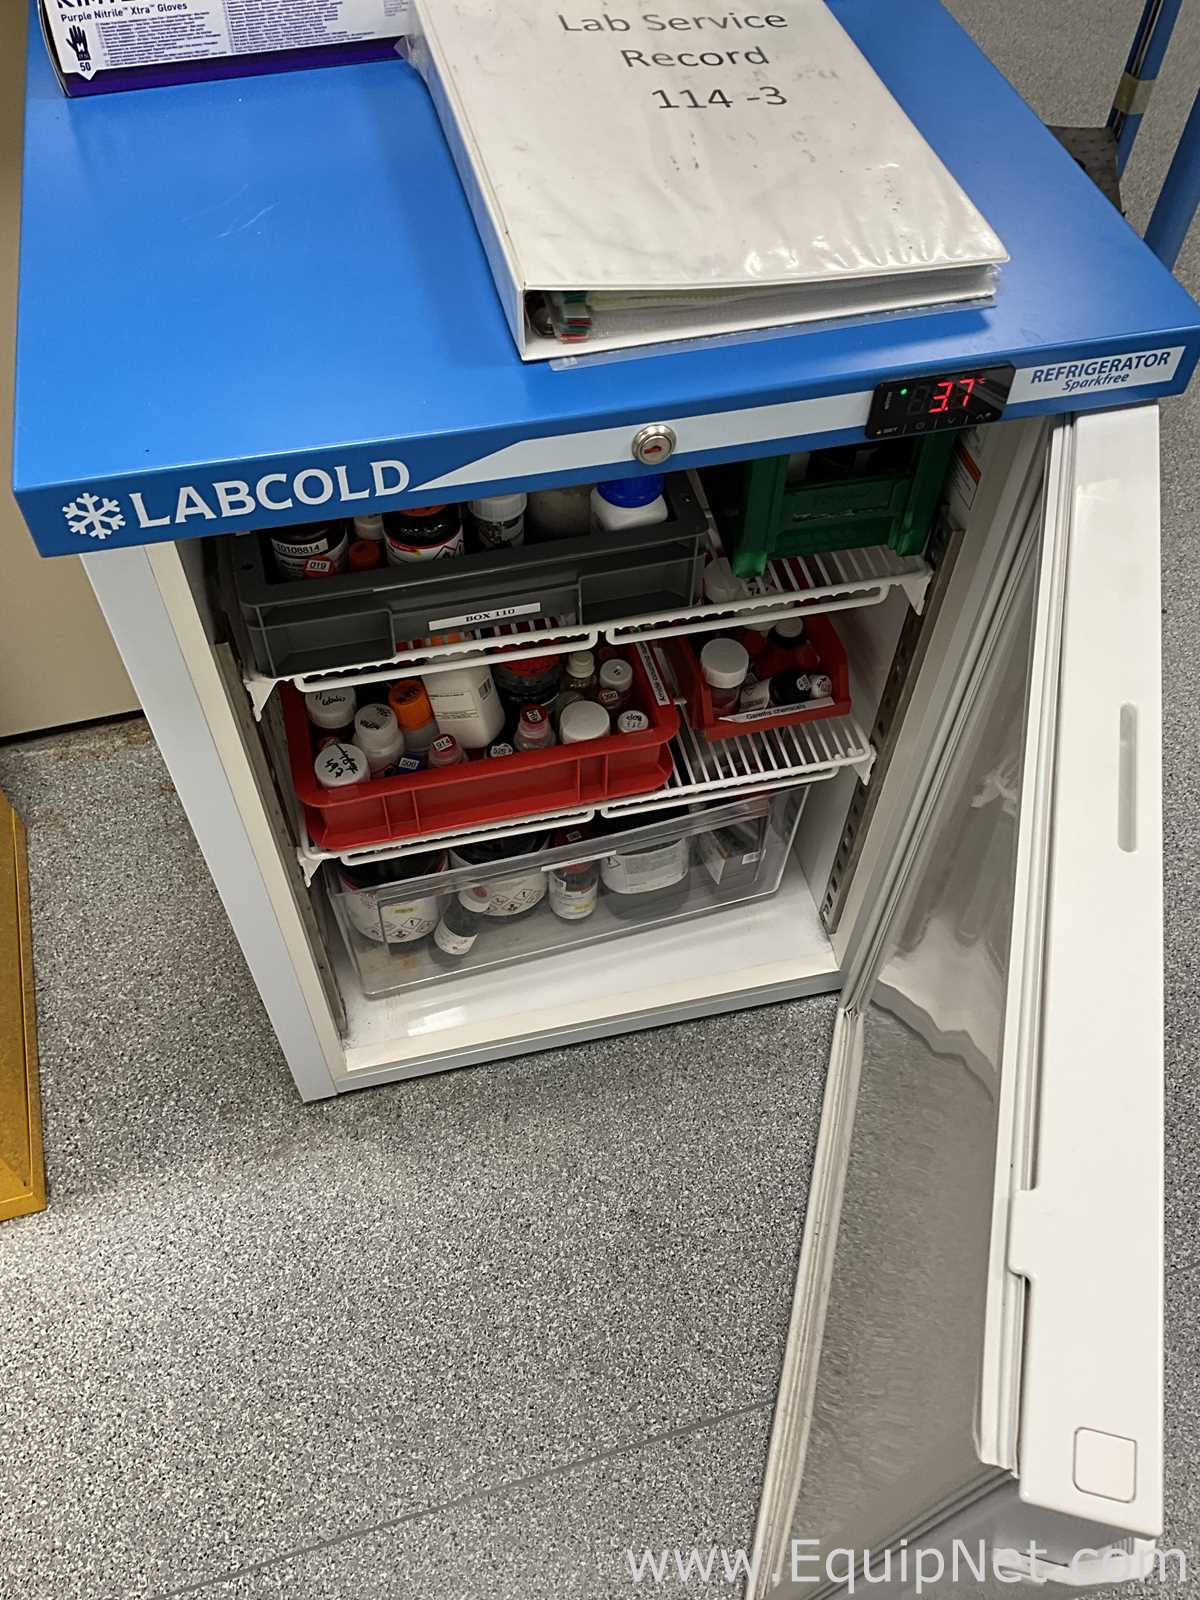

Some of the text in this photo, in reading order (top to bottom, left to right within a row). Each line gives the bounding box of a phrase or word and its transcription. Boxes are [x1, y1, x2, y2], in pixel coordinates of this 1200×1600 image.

[60, 13, 92, 23] Purple
[157, 3, 188, 13] Gloves
[557, 12, 789, 32] Lab Service
[79, 61, 92, 72] 50
[620, 46, 770, 68] Record
[651, 88, 734, 109] 114
[1030, 351, 1171, 385] REFRIGERATOR
[1062, 370, 1130, 392] Sparkfree
[128, 459, 411, 529] LABCOLD
[465, 608, 516, 623] BOX 110
